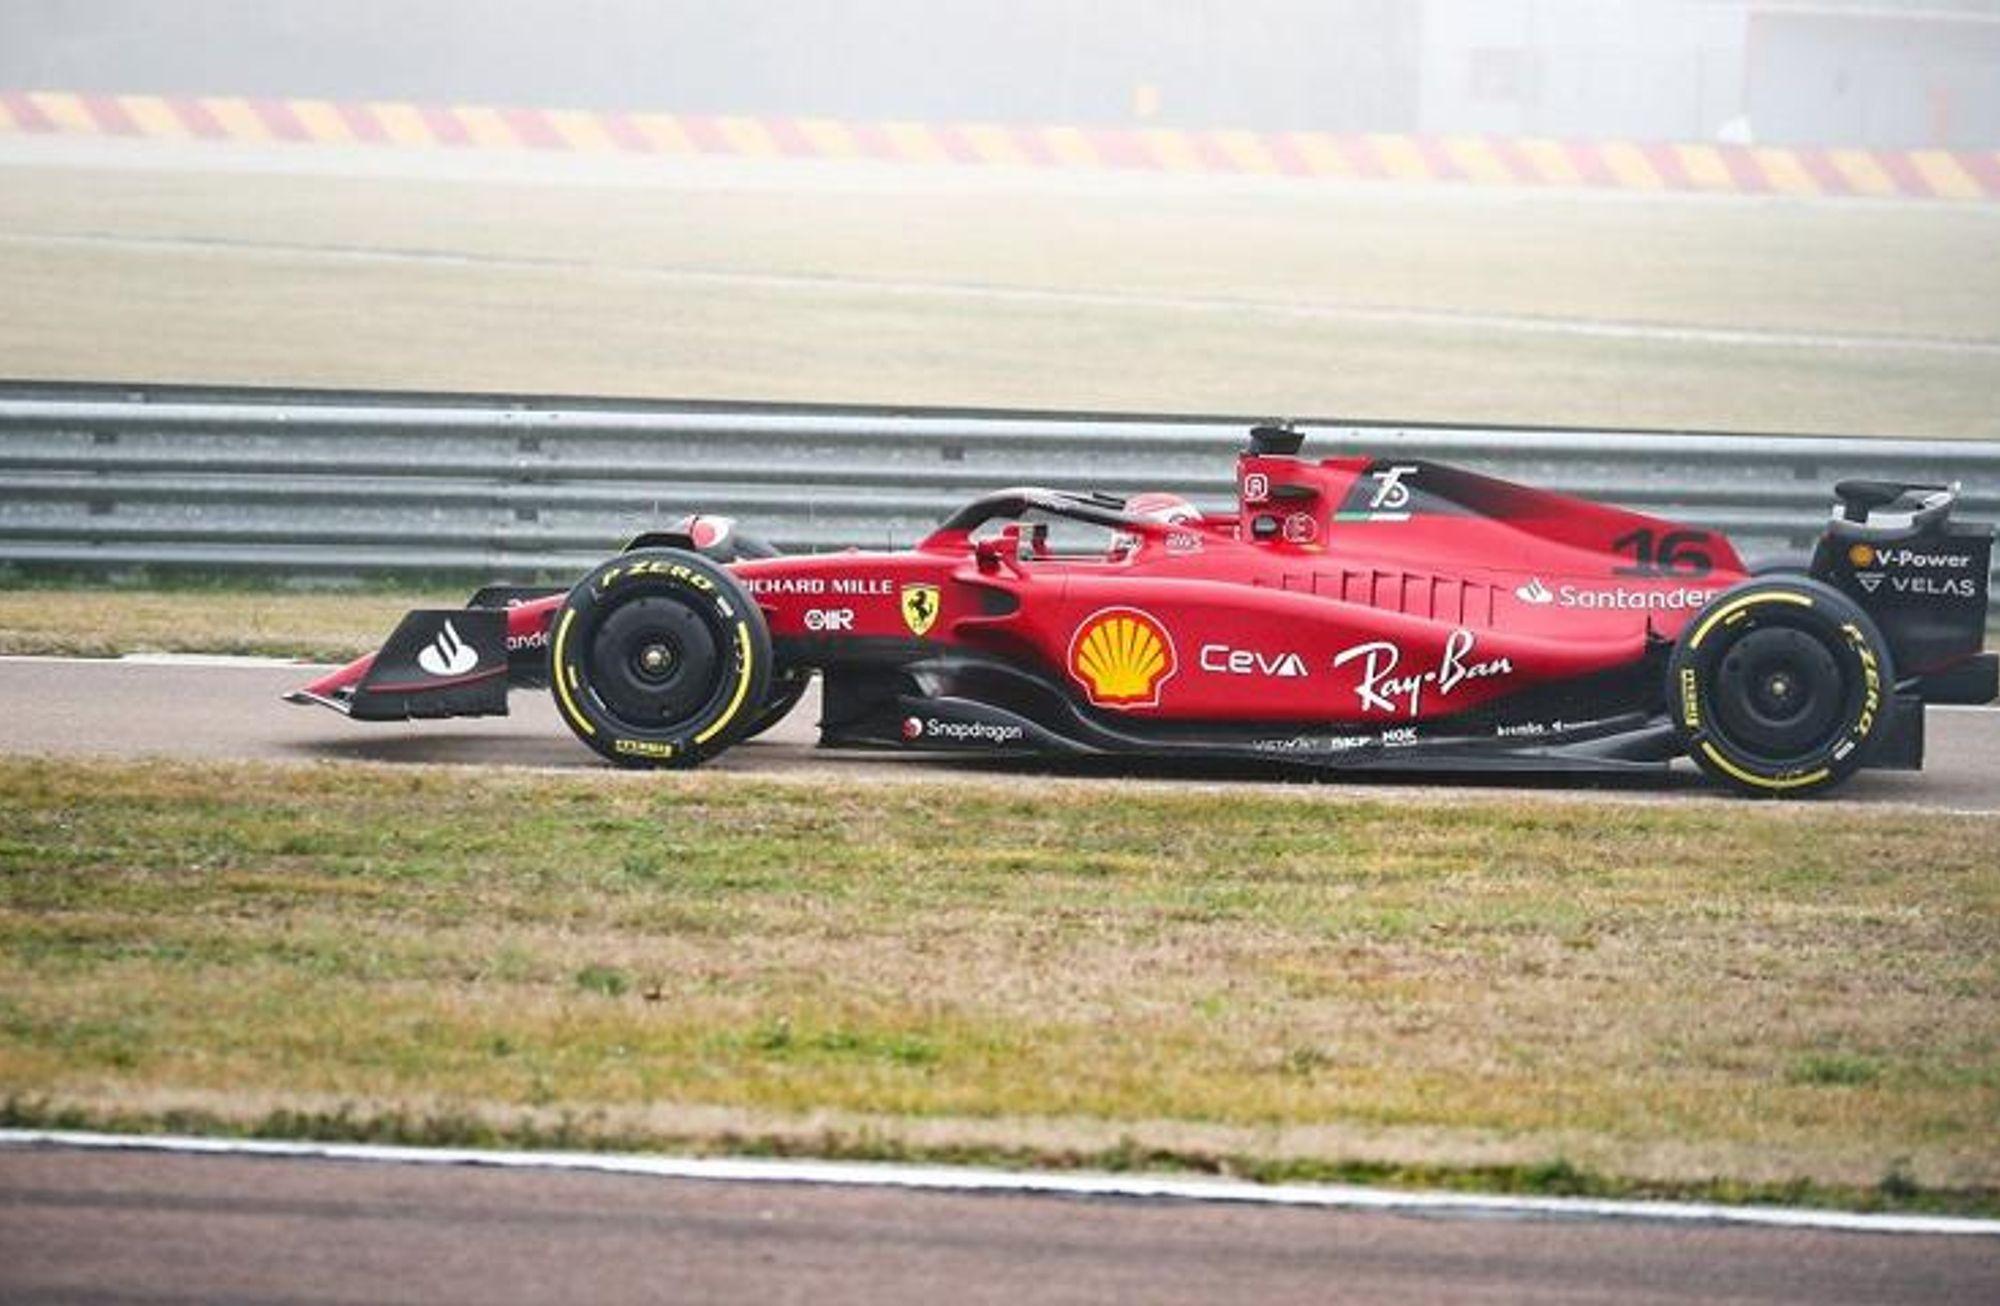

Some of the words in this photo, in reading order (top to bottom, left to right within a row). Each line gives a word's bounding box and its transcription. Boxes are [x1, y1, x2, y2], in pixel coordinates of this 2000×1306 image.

[1612, 527, 1714, 578] 16
[1875, 549, 1970, 568] V-Power
[626, 561, 715, 590] ZERO
[831, 579, 893, 595] MILLE
[1892, 576, 1975, 597] VELAS
[1333, 629, 1514, 717] Ray-Ban
[926, 718, 1023, 743] Snapdragon
